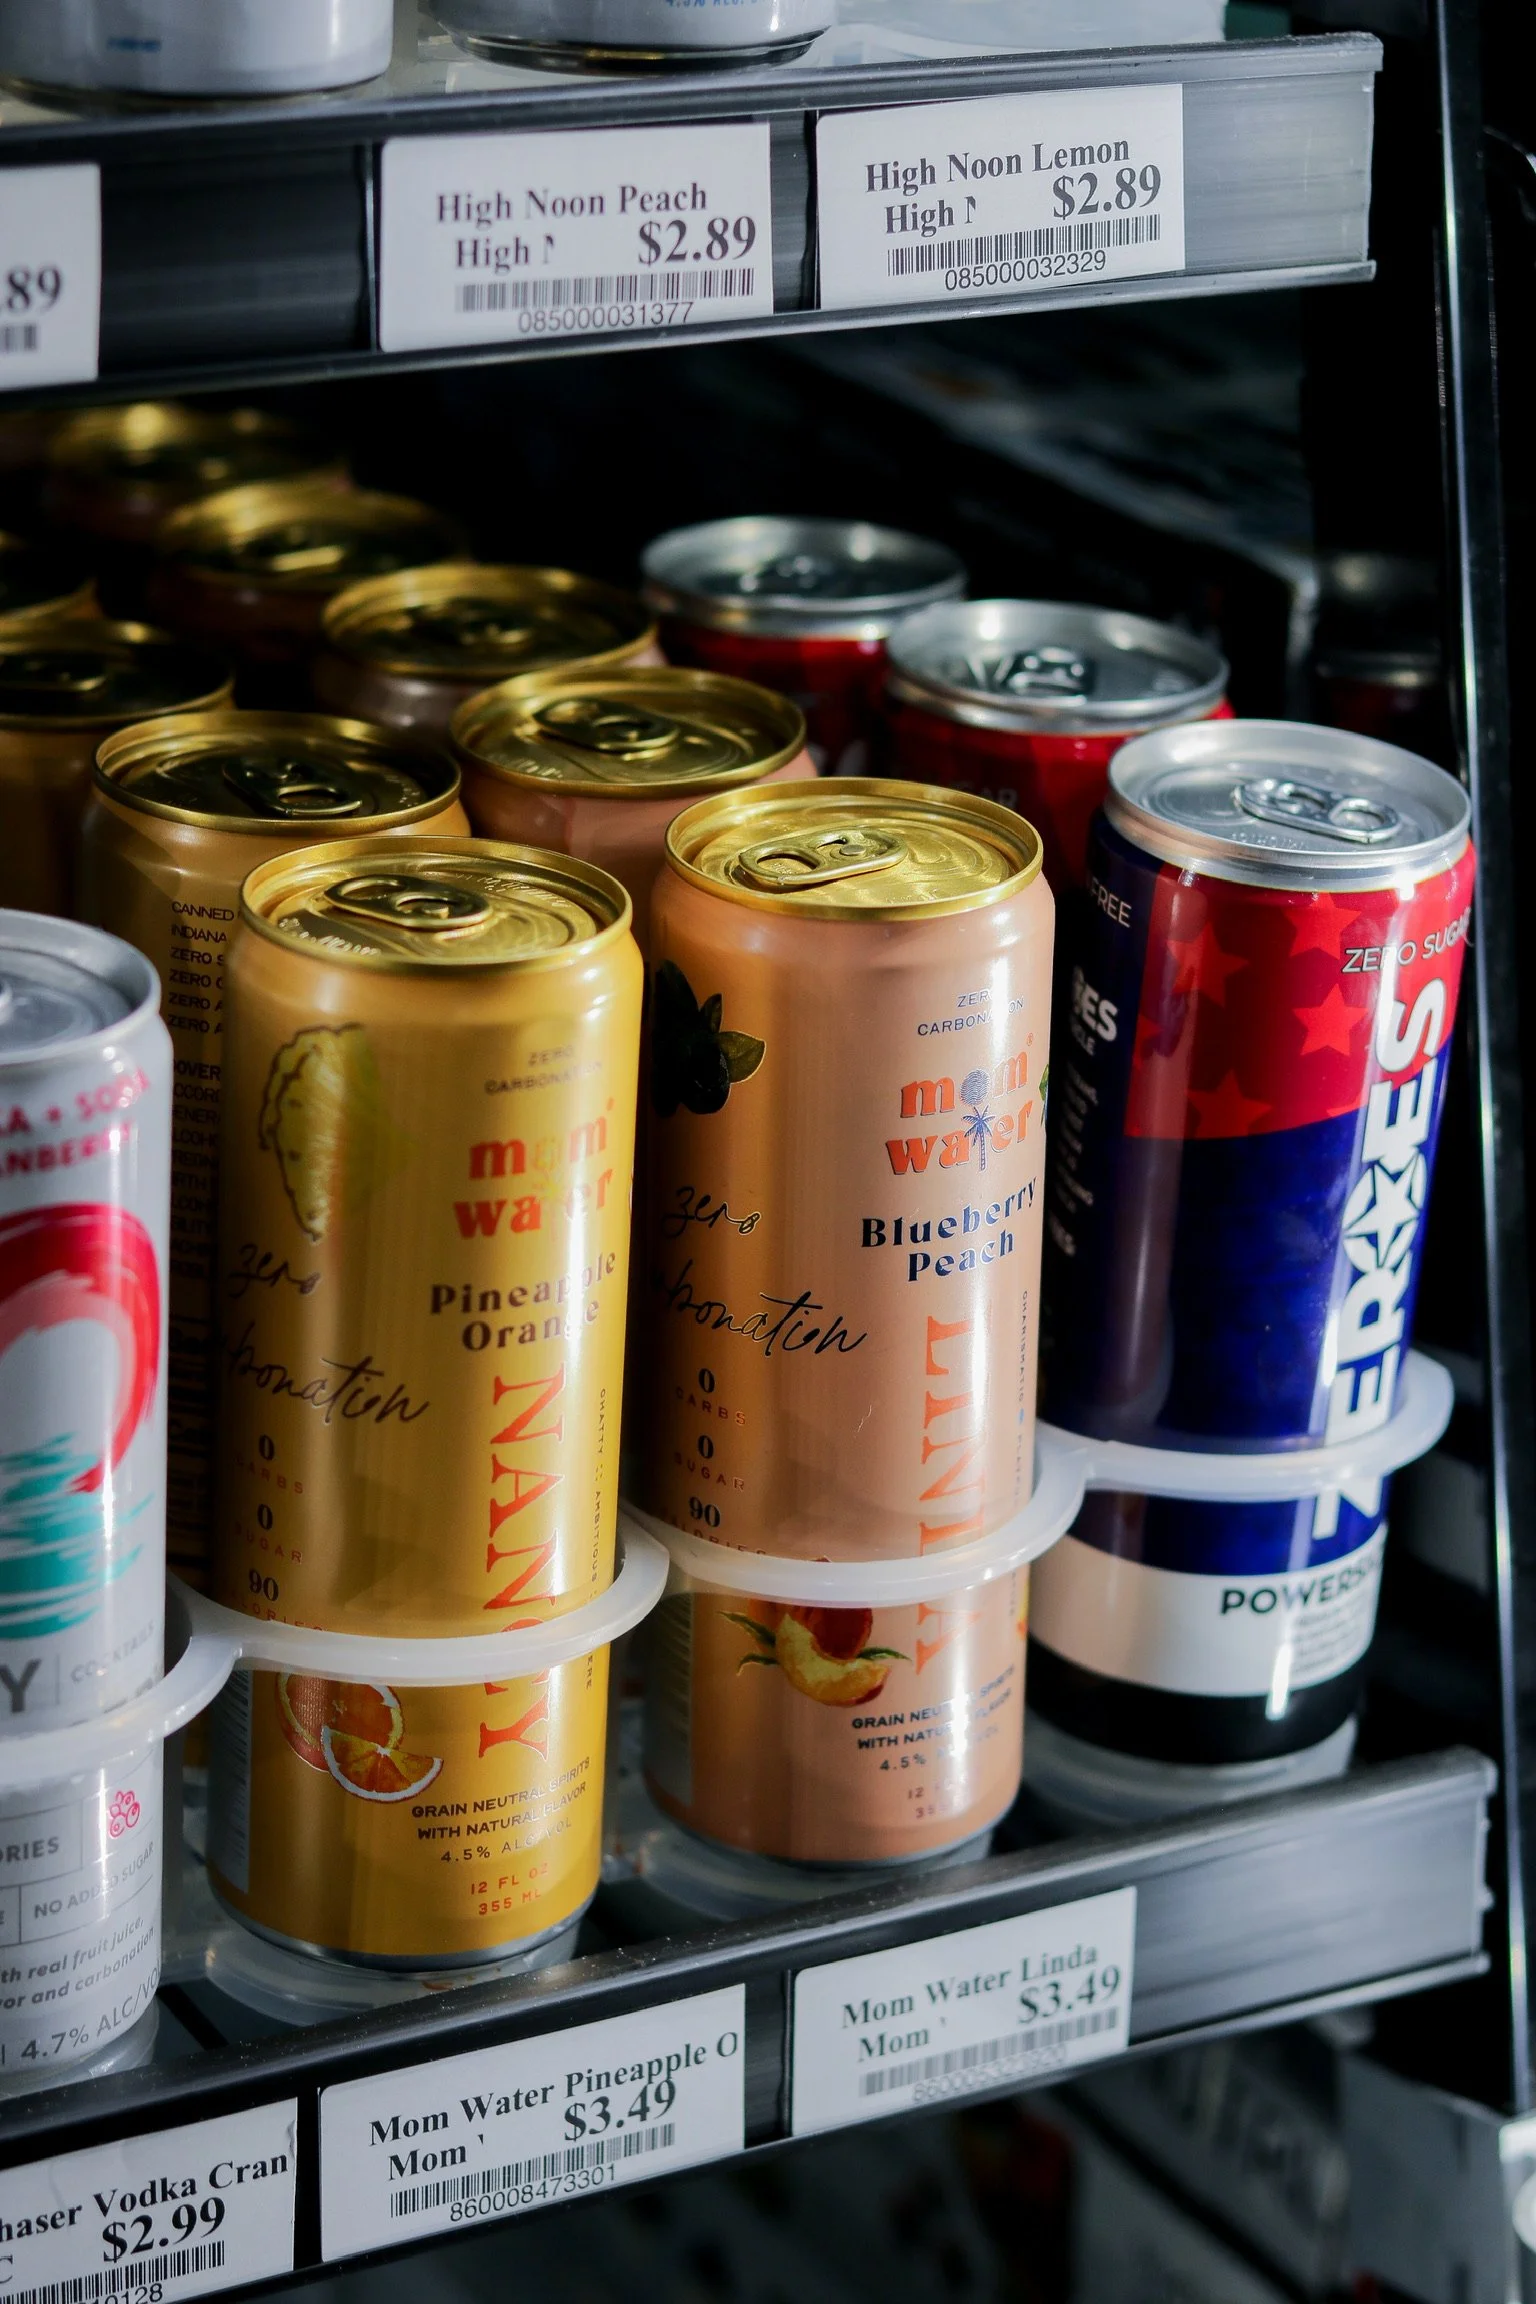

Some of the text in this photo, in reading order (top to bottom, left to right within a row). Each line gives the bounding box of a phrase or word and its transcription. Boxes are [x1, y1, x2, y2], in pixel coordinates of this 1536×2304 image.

[866, 139, 1131, 197] High Noon Lemon
[437, 183, 707, 229] High Noon Peach
[1053, 164, 1162, 221] $2.89
[885, 196, 955, 238] High
[456, 236, 530, 276] High
[639, 215, 757, 267] $2.89
[945, 249, 1107, 291] 085000032329
[518, 301, 695, 333] 085000031377
[172, 901, 235, 922] CANNED
[917, 998, 1024, 1037] CARBONON
[453, 1168, 614, 1240] waer
[861, 1177, 1038, 1248] Blueberry
[908, 1229, 1014, 1283] Peach
[462, 1299, 600, 1352] Orane
[697, 1367, 716, 1394] 0
[259, 1434, 275, 1461] 0
[697, 1434, 714, 1460] 0
[257, 1503, 273, 1531] 0
[688, 1495, 721, 1529] 90
[249, 1567, 280, 1602] 90
[852, 1712, 905, 1730] GRAIN
[858, 1734, 899, 1750] WITH
[880, 1753, 926, 1772] 4.5%
[412, 1756, 590, 1819] GRAIN NEUTRAL SPIRITS
[908, 1787, 924, 1800] 12
[417, 1780, 587, 1841] WITH NATURAL FLAVOR
[441, 1845, 491, 1863] 4.5%
[34, 1899, 63, 1920] NO
[67, 1875, 119, 1910] ADDD
[122, 1841, 154, 1882] SUGAR
[471, 1862, 548, 1895] 12 FL OZ
[478, 1889, 542, 1916] 355 ML
[28, 1954, 68, 1979] real
[72, 1937, 108, 1971] fruit
[32, 1980, 70, 2005] and
[75, 1926, 154, 1992] carbonation
[842, 1943, 1098, 2029] Mom Water Linda
[1017, 1964, 1121, 2025] $3.49
[21, 2023, 89, 2060] 4.7%
[858, 2026, 930, 2063] Mom
[369, 2031, 739, 2147] Mom Water Pineapple O
[564, 2078, 677, 2142] $3.49
[388, 2143, 468, 2182] Mom
[93, 2176, 198, 2219] Vodka
[208, 2153, 289, 2190] Cran
[450, 2162, 617, 2222] 860008473301
[102, 2195, 226, 2264] $2.99
